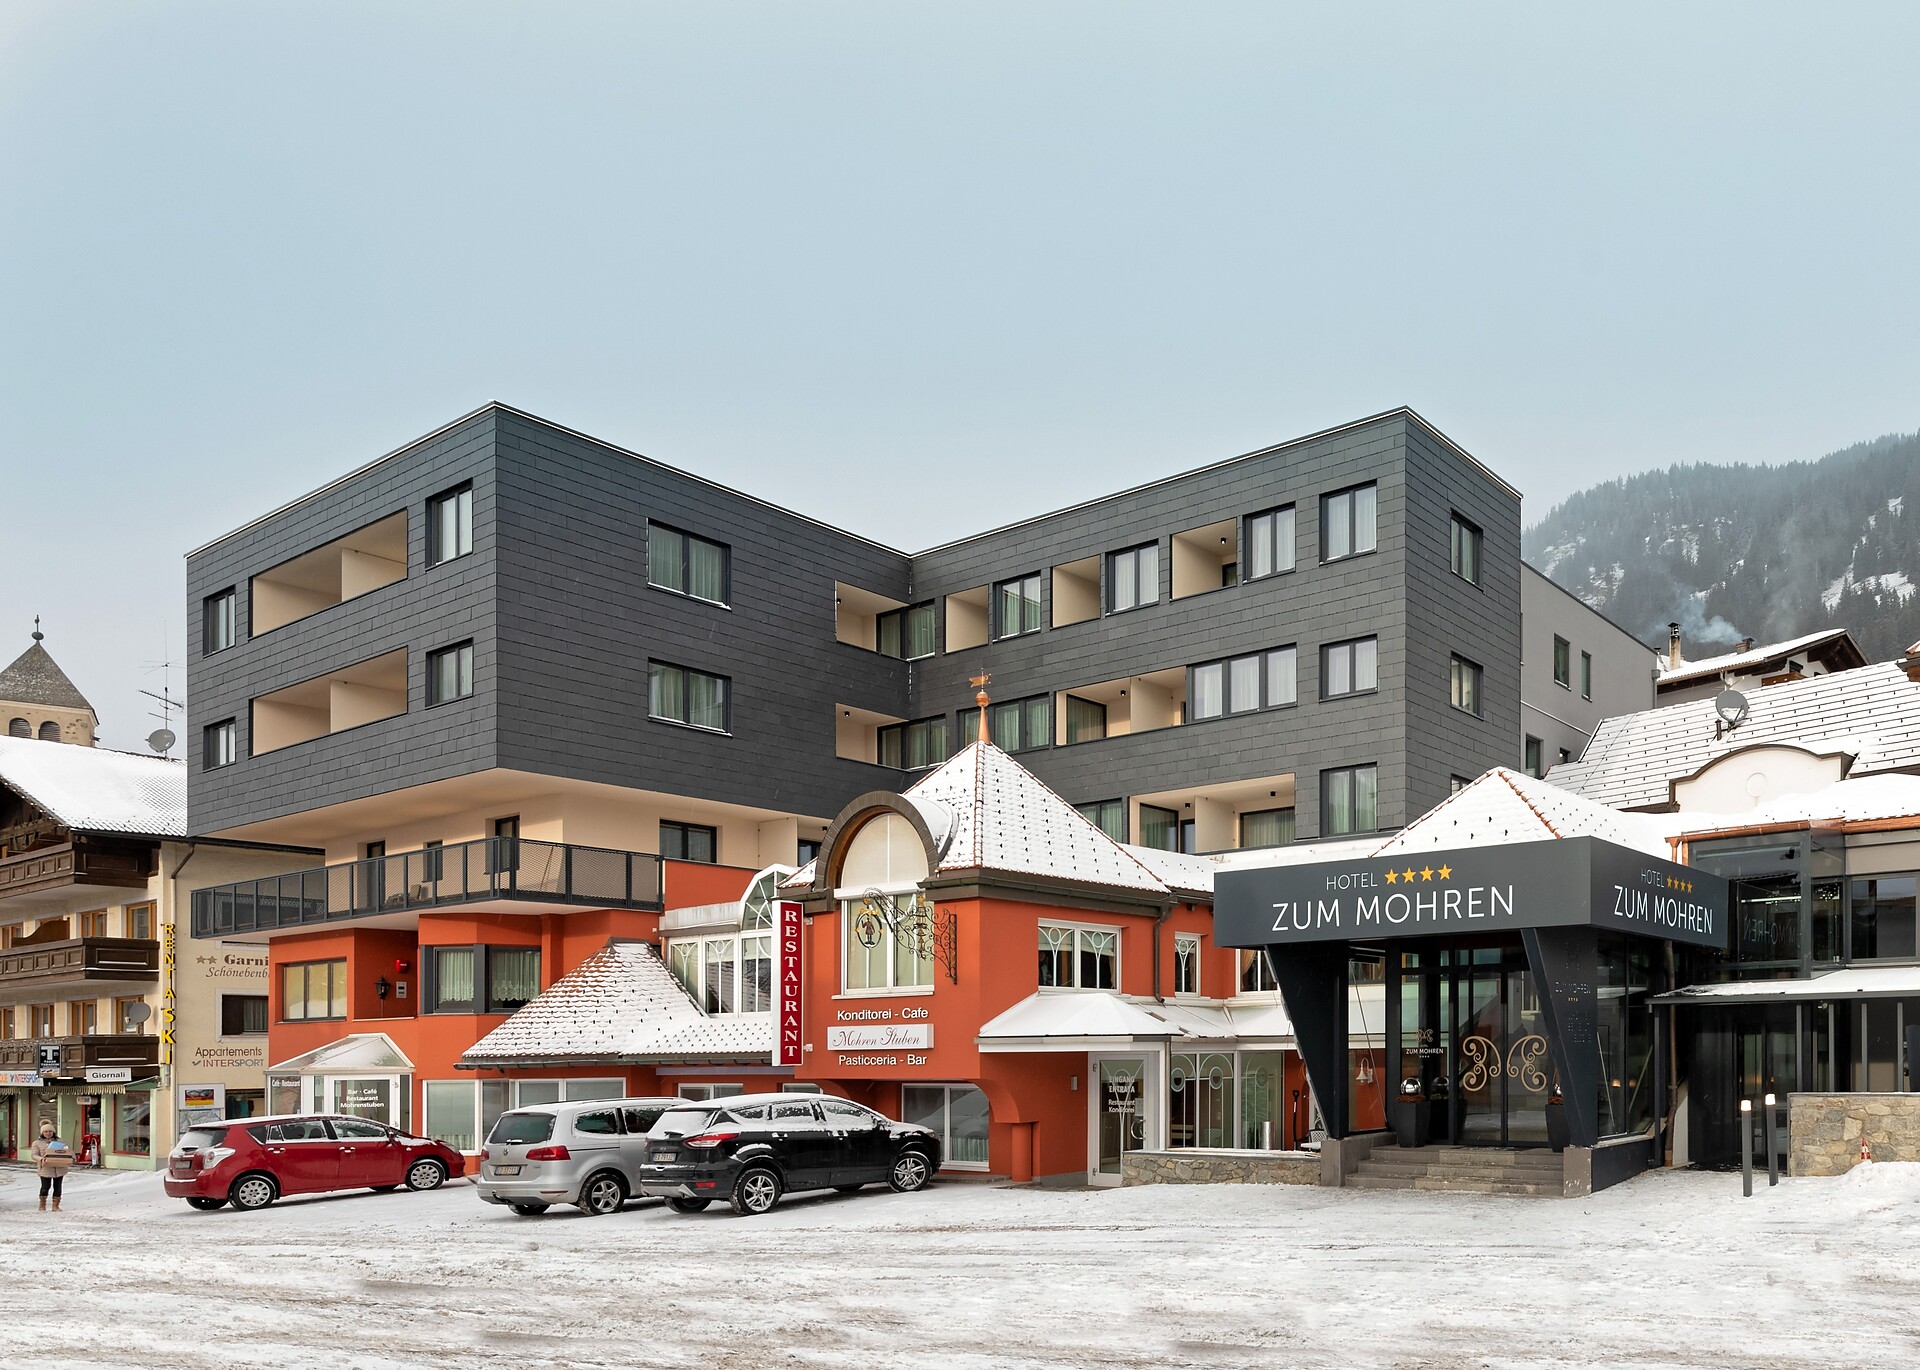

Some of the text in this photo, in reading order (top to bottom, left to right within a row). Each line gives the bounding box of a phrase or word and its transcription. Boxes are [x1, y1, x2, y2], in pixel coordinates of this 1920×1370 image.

[1326, 872, 1378, 890] HOTEL
[1640, 868, 1664, 888] HOTEL
[1272, 884, 1514, 932] ZUM MOHREN
[1614, 885, 1713, 935] ZUM MOHREN
[224, 954, 268, 966] Garni
[784, 910, 798, 1056] RESTAURANT
[161, 923, 176, 1064] RENT A SKI
[837, 1009, 892, 1020] Konditorei
[902, 1007, 928, 1019] Cafe
[832, 1026, 920, 1046] Mohren Stuben
[195, 1047, 262, 1058] Appartements
[838, 1055, 896, 1066] Pasticceria
[907, 1054, 927, 1065] Bar
[203, 1059, 264, 1068] INTERSPORT
